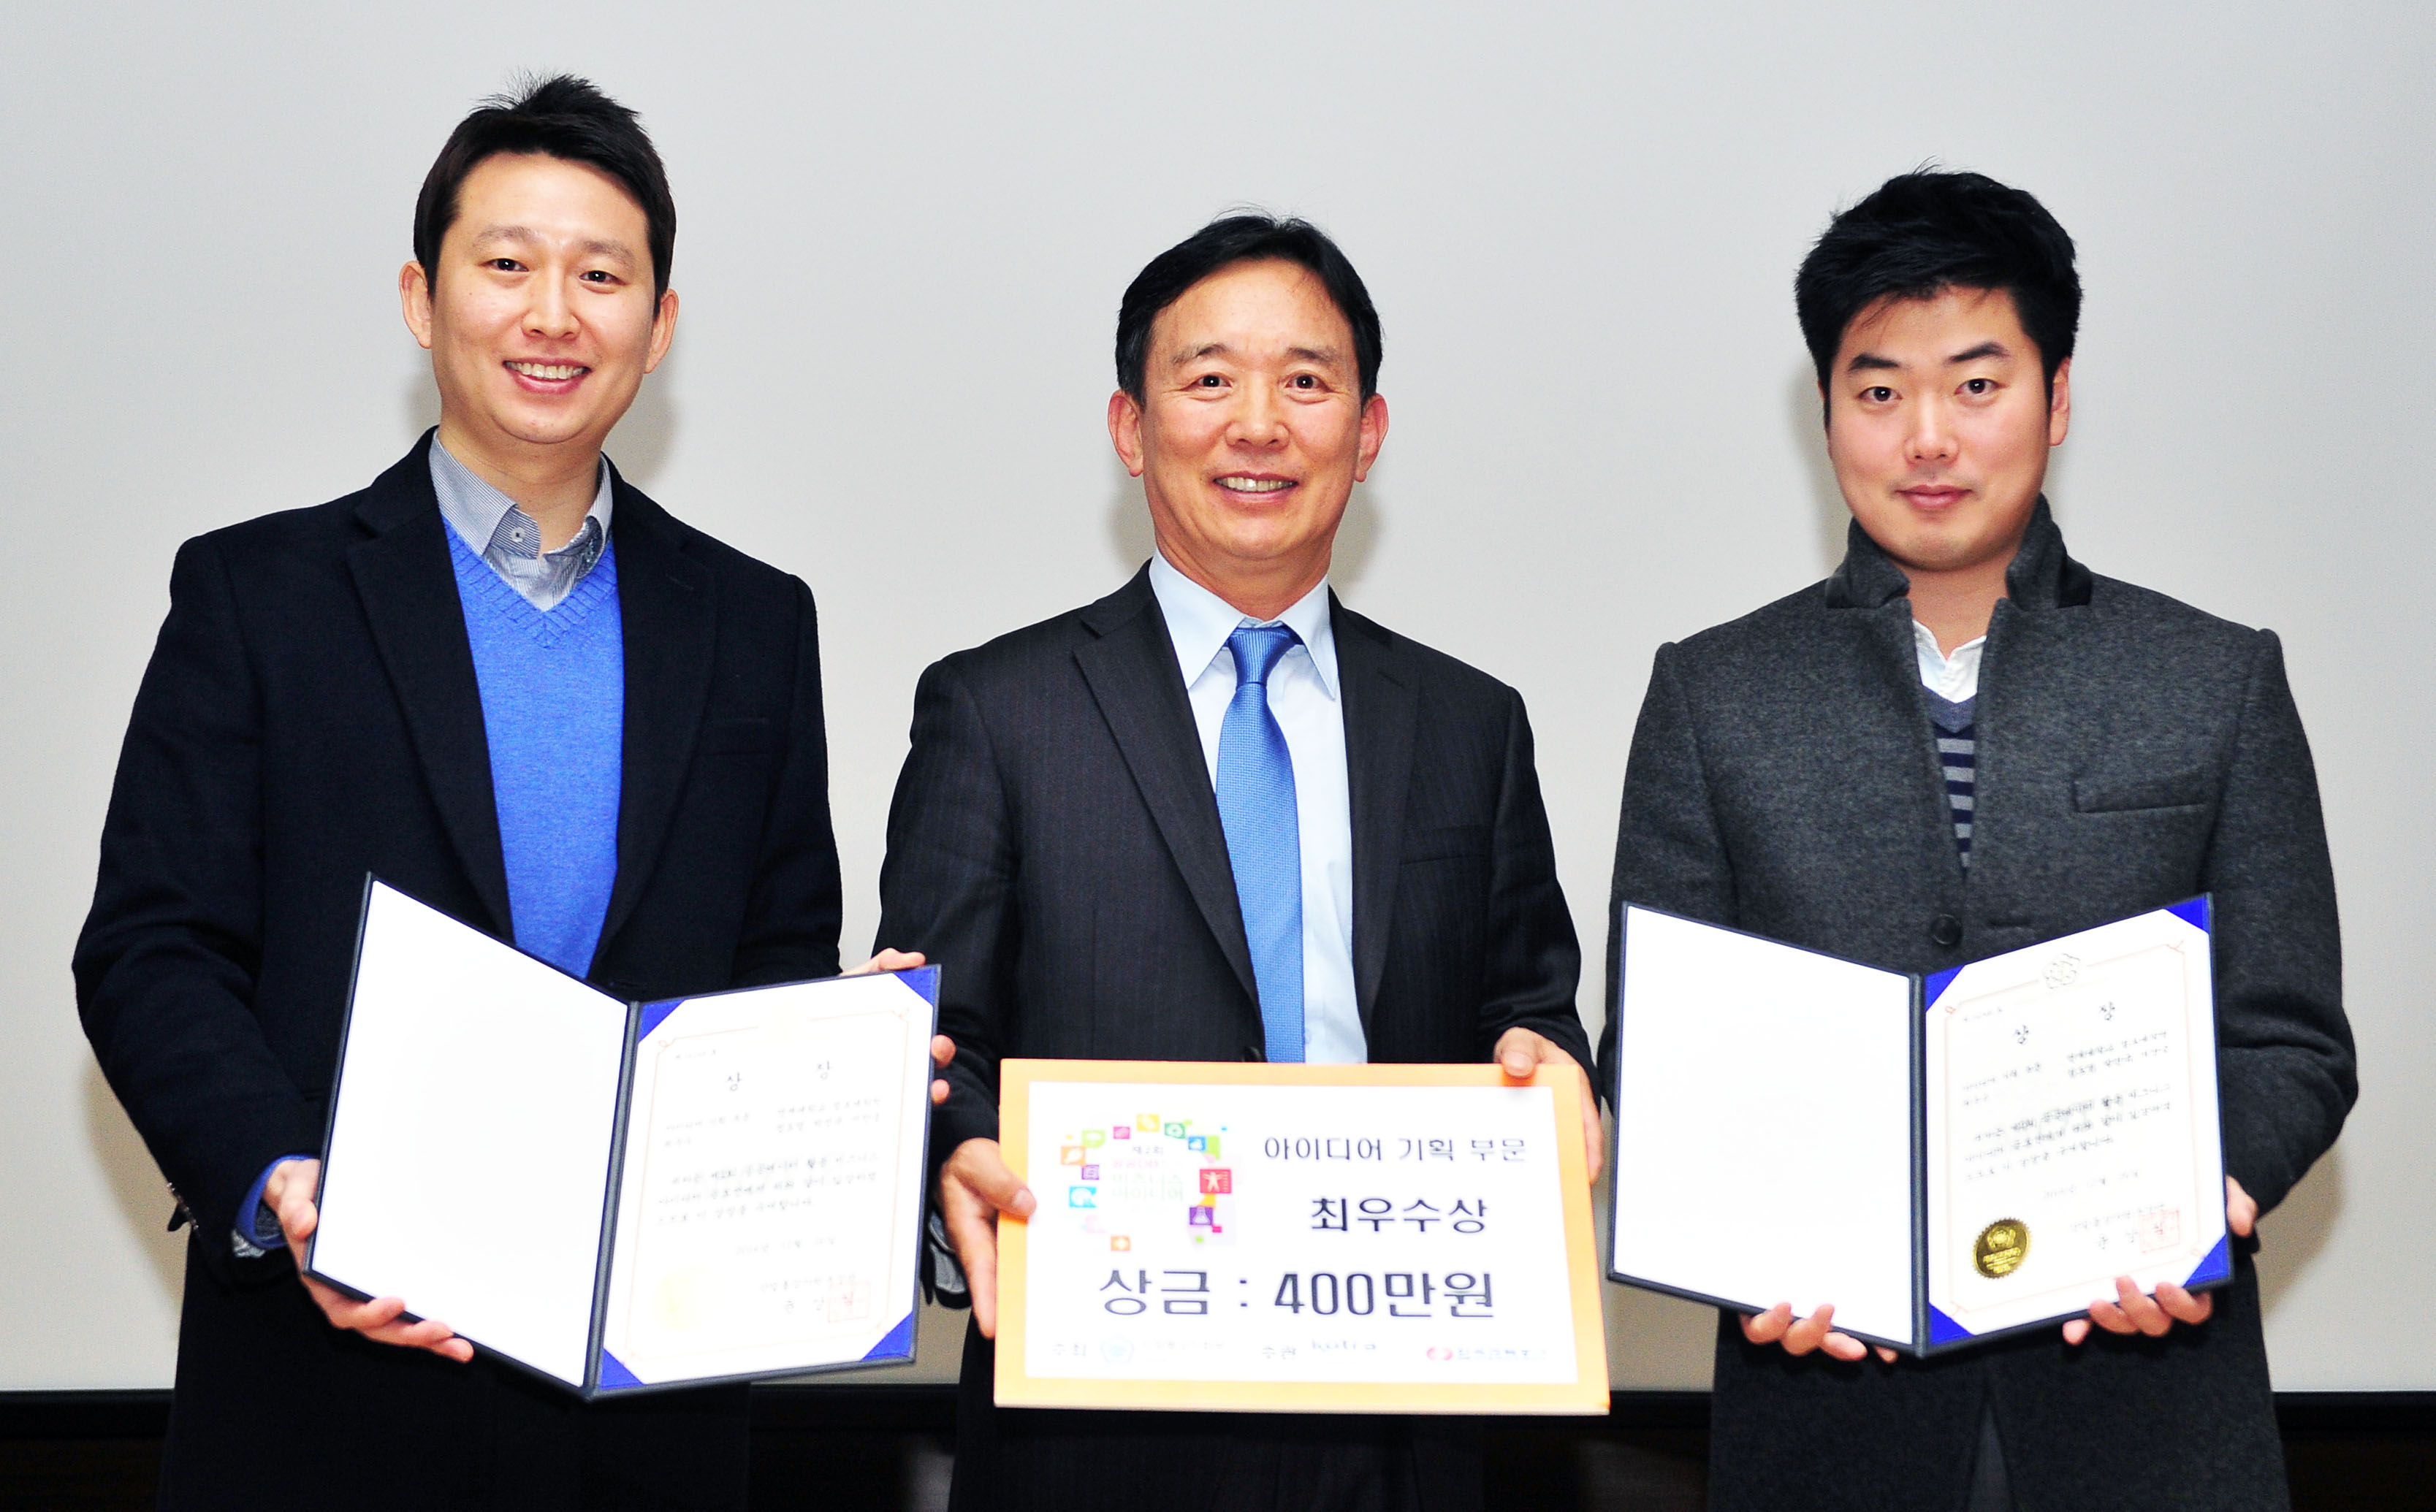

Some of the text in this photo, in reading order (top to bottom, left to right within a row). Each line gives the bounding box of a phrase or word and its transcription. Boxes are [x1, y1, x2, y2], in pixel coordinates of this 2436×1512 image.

[1264, 1137, 1526, 1162] 아이디어 기획 부문
[1311, 1196, 1488, 1234] 최우수상
[1099, 1269, 1211, 1316] 상금
[1274, 1271, 1494, 1318] 400만원
